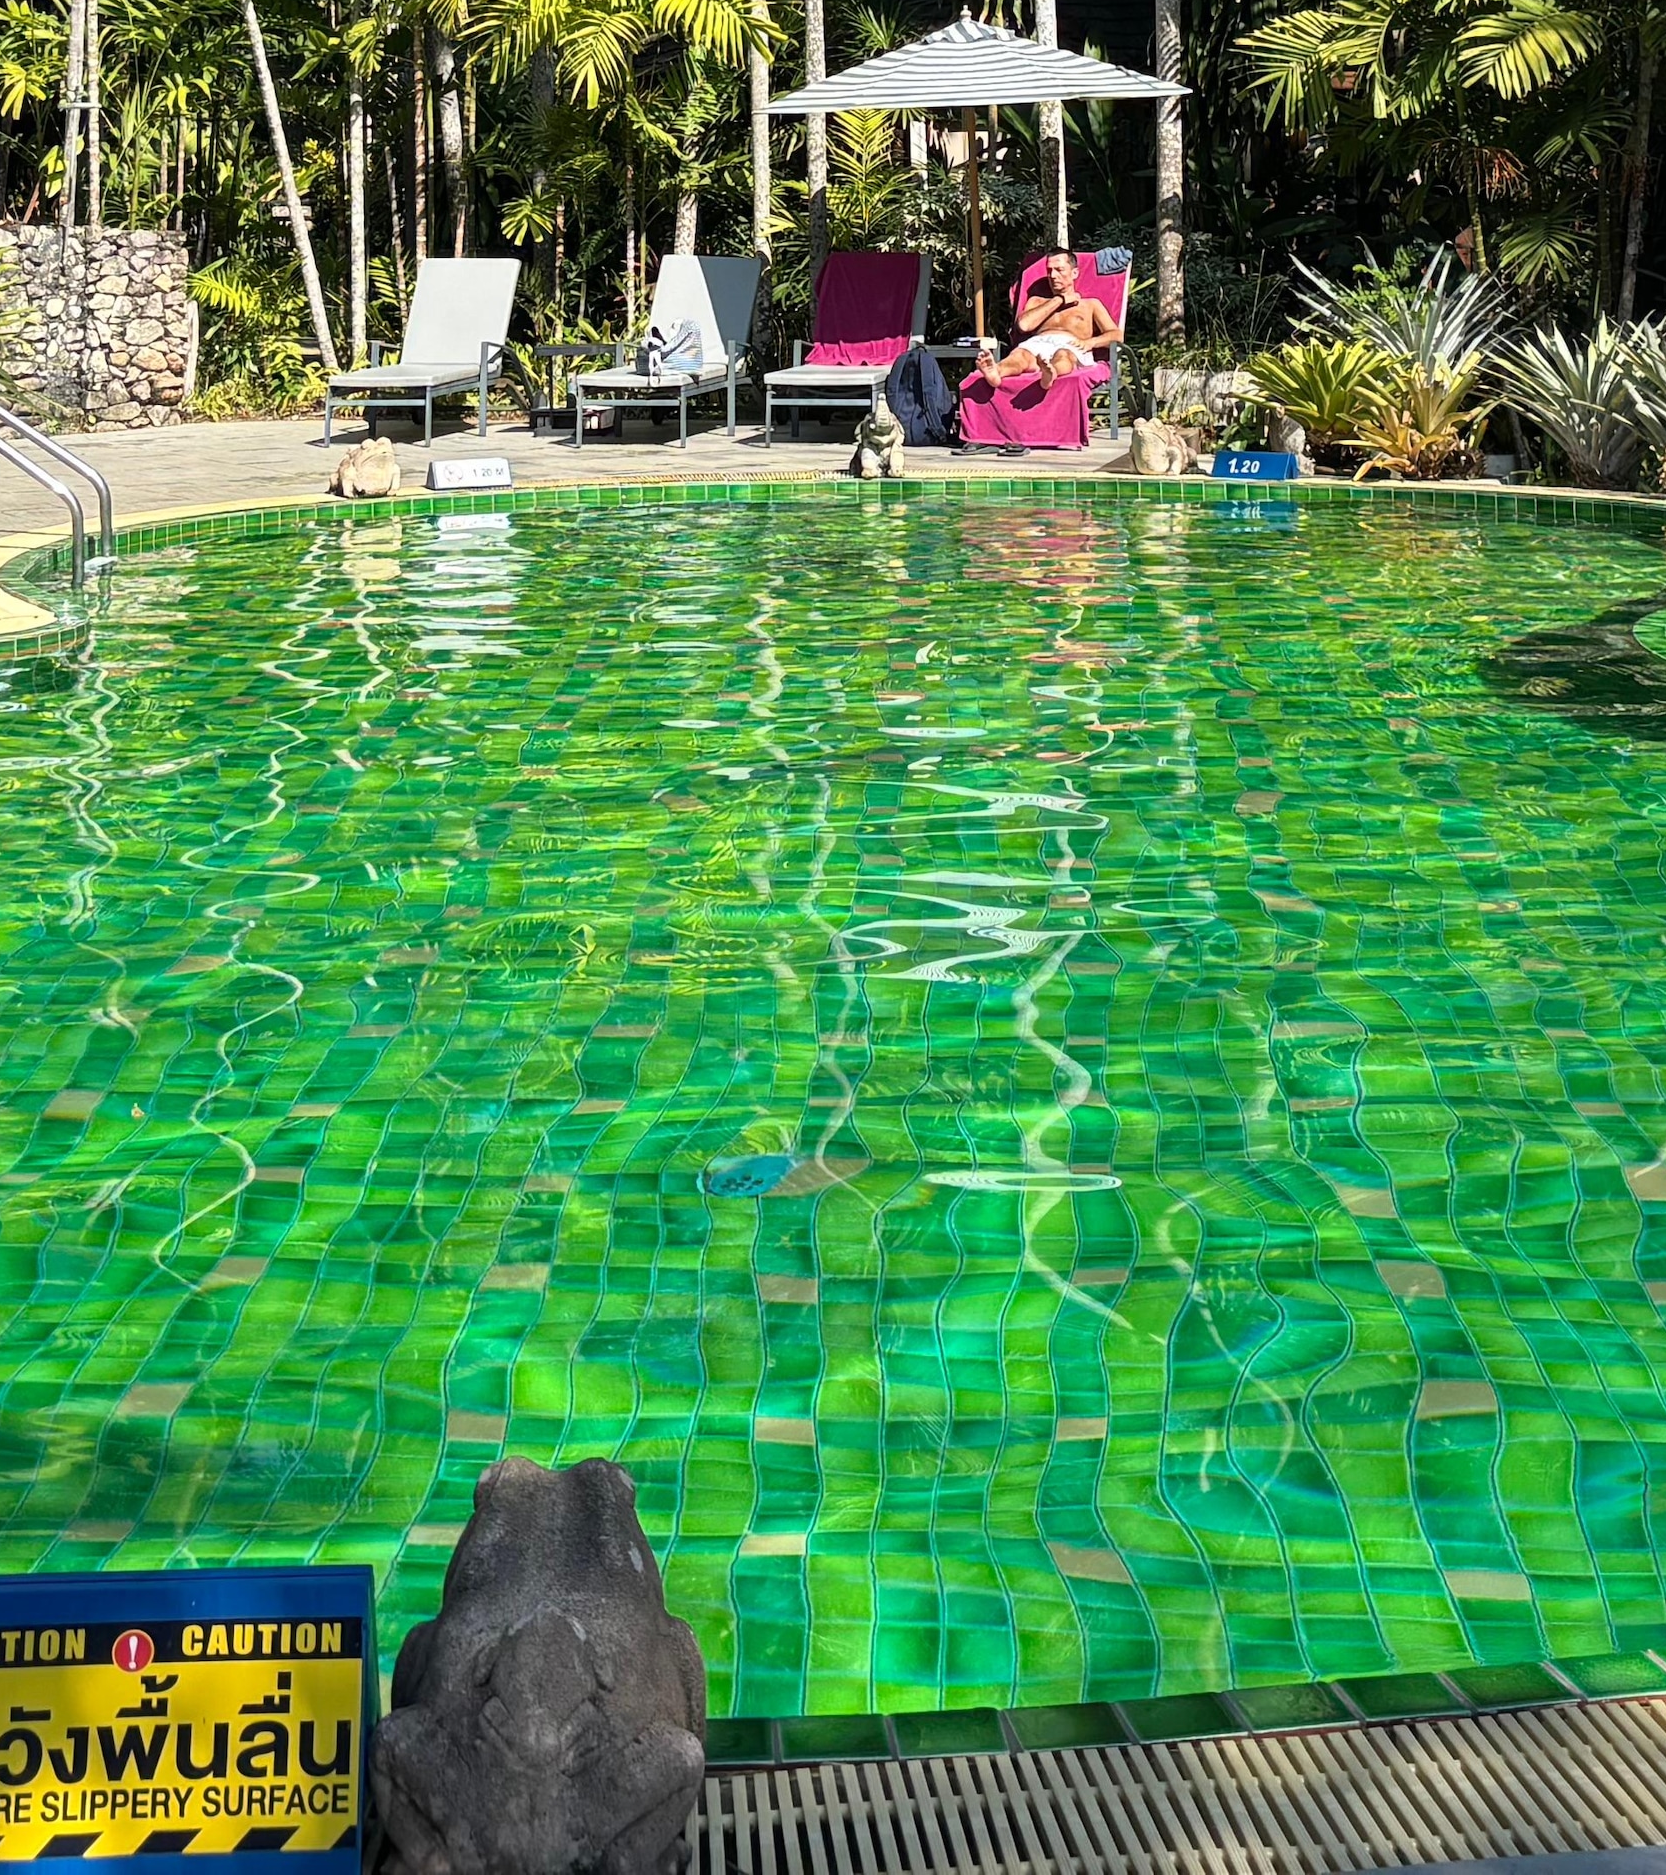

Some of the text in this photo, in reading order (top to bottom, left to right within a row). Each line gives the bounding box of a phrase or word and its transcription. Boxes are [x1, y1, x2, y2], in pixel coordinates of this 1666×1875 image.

[1227, 457, 1260, 474] 1.20
[181, 1622, 342, 1657] CAUTION
[40, 1787, 194, 1823] SLIPPERY
[201, 1783, 350, 1817] SURFACE
